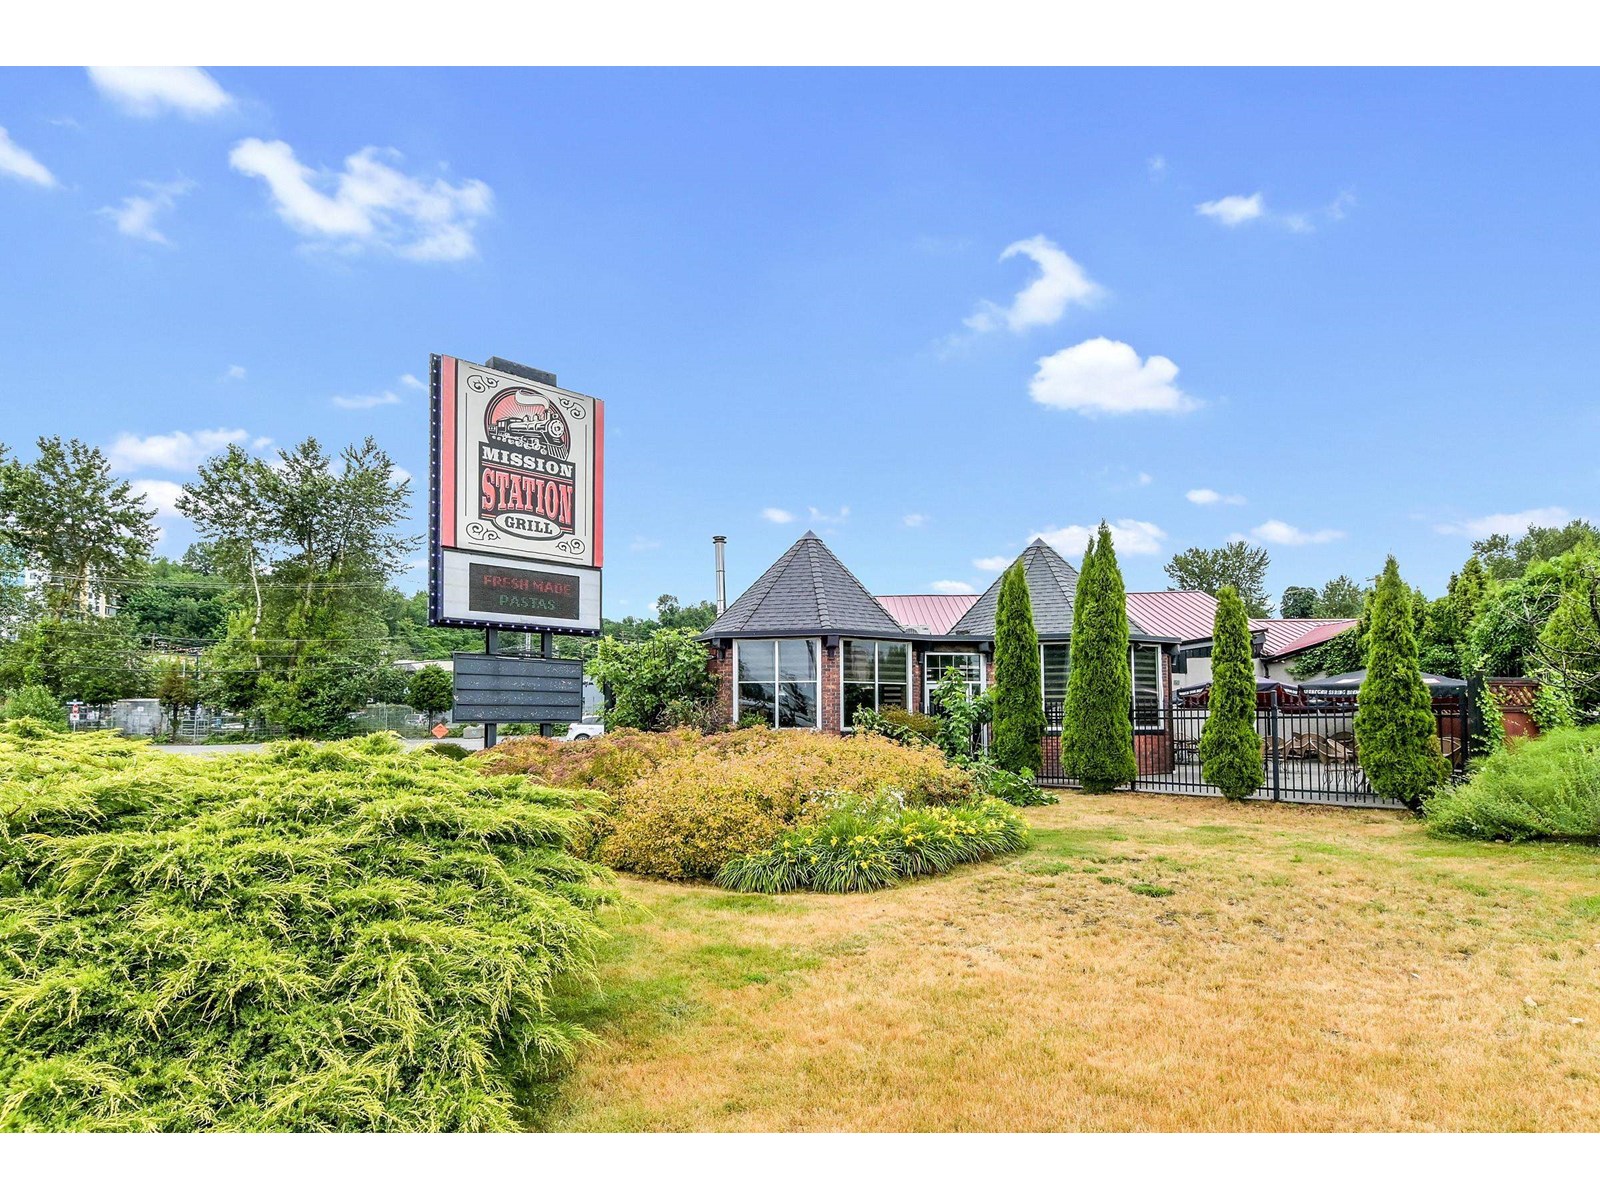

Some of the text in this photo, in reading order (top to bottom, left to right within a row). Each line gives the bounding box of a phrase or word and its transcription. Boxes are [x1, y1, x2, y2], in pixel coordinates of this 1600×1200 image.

[482, 446, 573, 478] MISSION
[482, 468, 573, 525] STATION
[504, 515, 553, 535] GRILL
[483, 575, 571, 595] FRESH MADE
[499, 594, 556, 611] PASTAS
